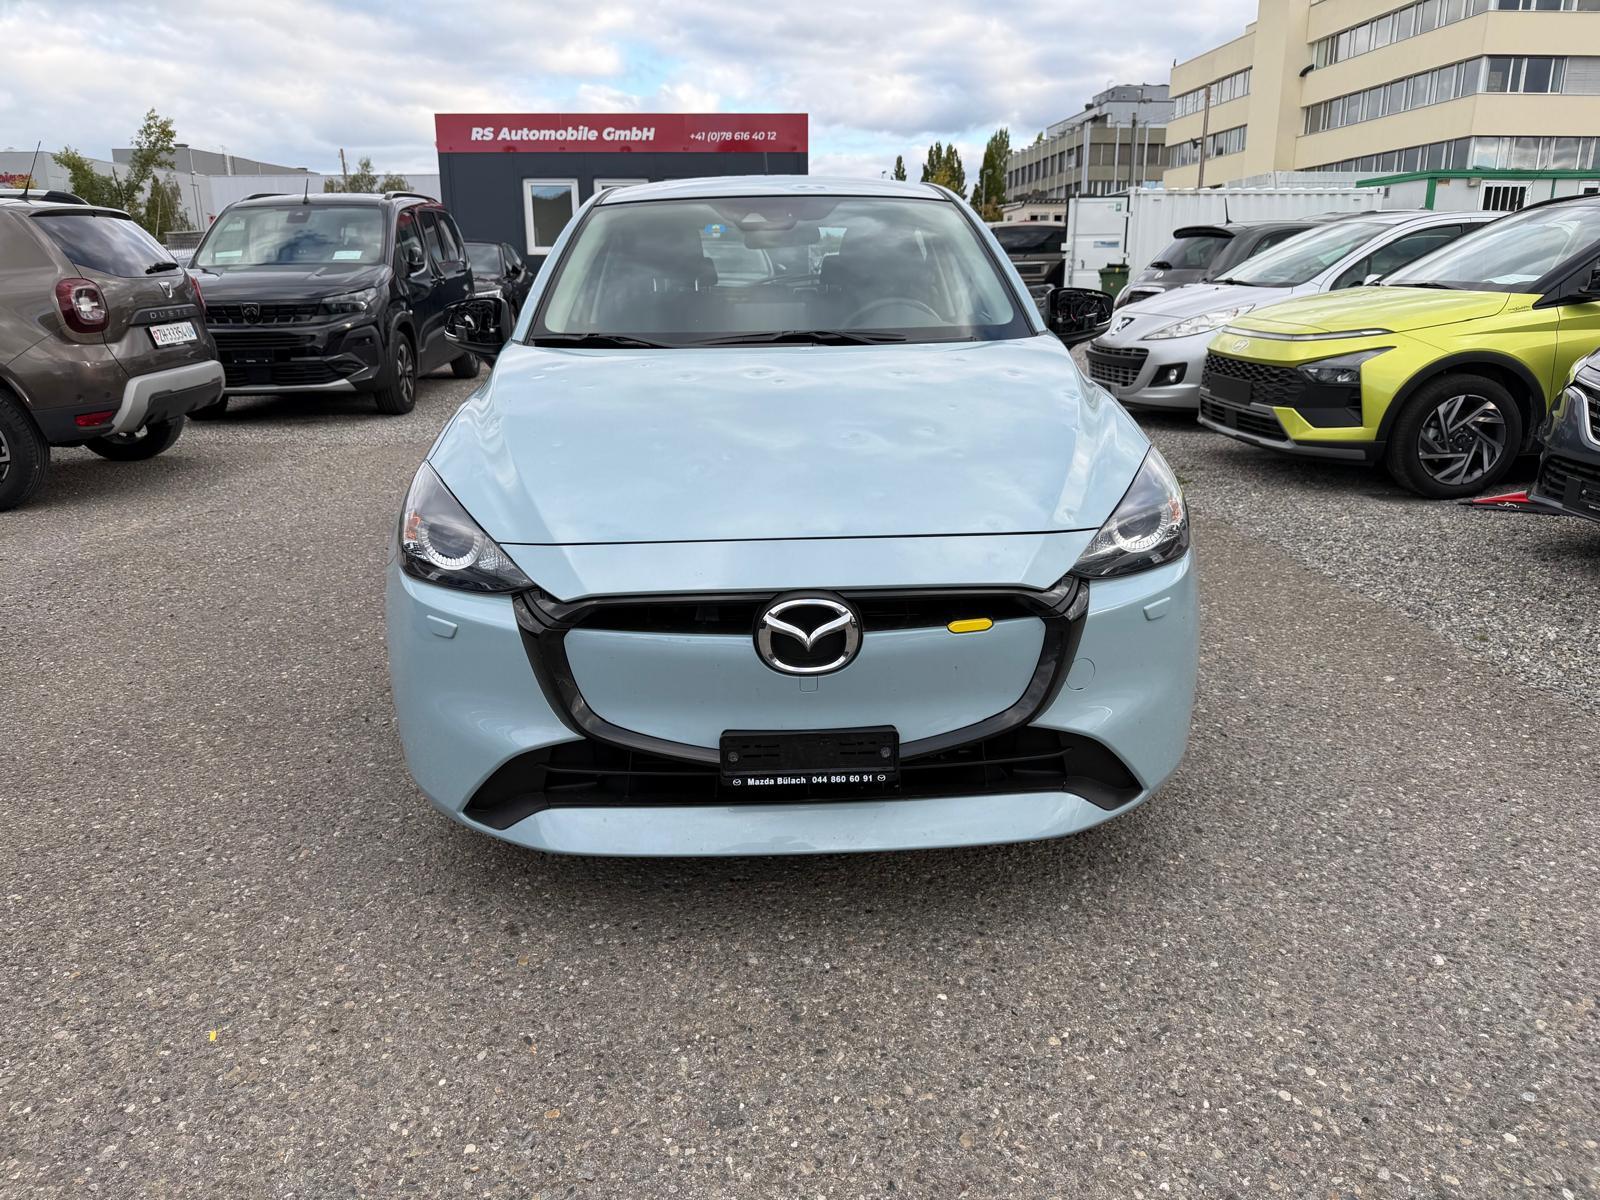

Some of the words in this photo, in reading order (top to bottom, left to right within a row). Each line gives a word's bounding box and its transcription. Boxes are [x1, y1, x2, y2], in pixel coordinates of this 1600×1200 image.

[471, 127, 494, 141] RS
[497, 126, 598, 141] Automobile
[602, 127, 655, 141] GmbH
[690, 132, 705, 141] +41
[707, 131, 732, 142] (0)78
[734, 131, 750, 141] 616
[752, 131, 765, 141] 40
[767, 131, 777, 141] 12
[747, 777, 775, 786] Mazda
[777, 776, 806, 785] Bülach
[812, 775, 828, 784] 044
[830, 775, 846, 783] 860
[849, 775, 860, 783] 60
[863, 774, 873, 782] 91
